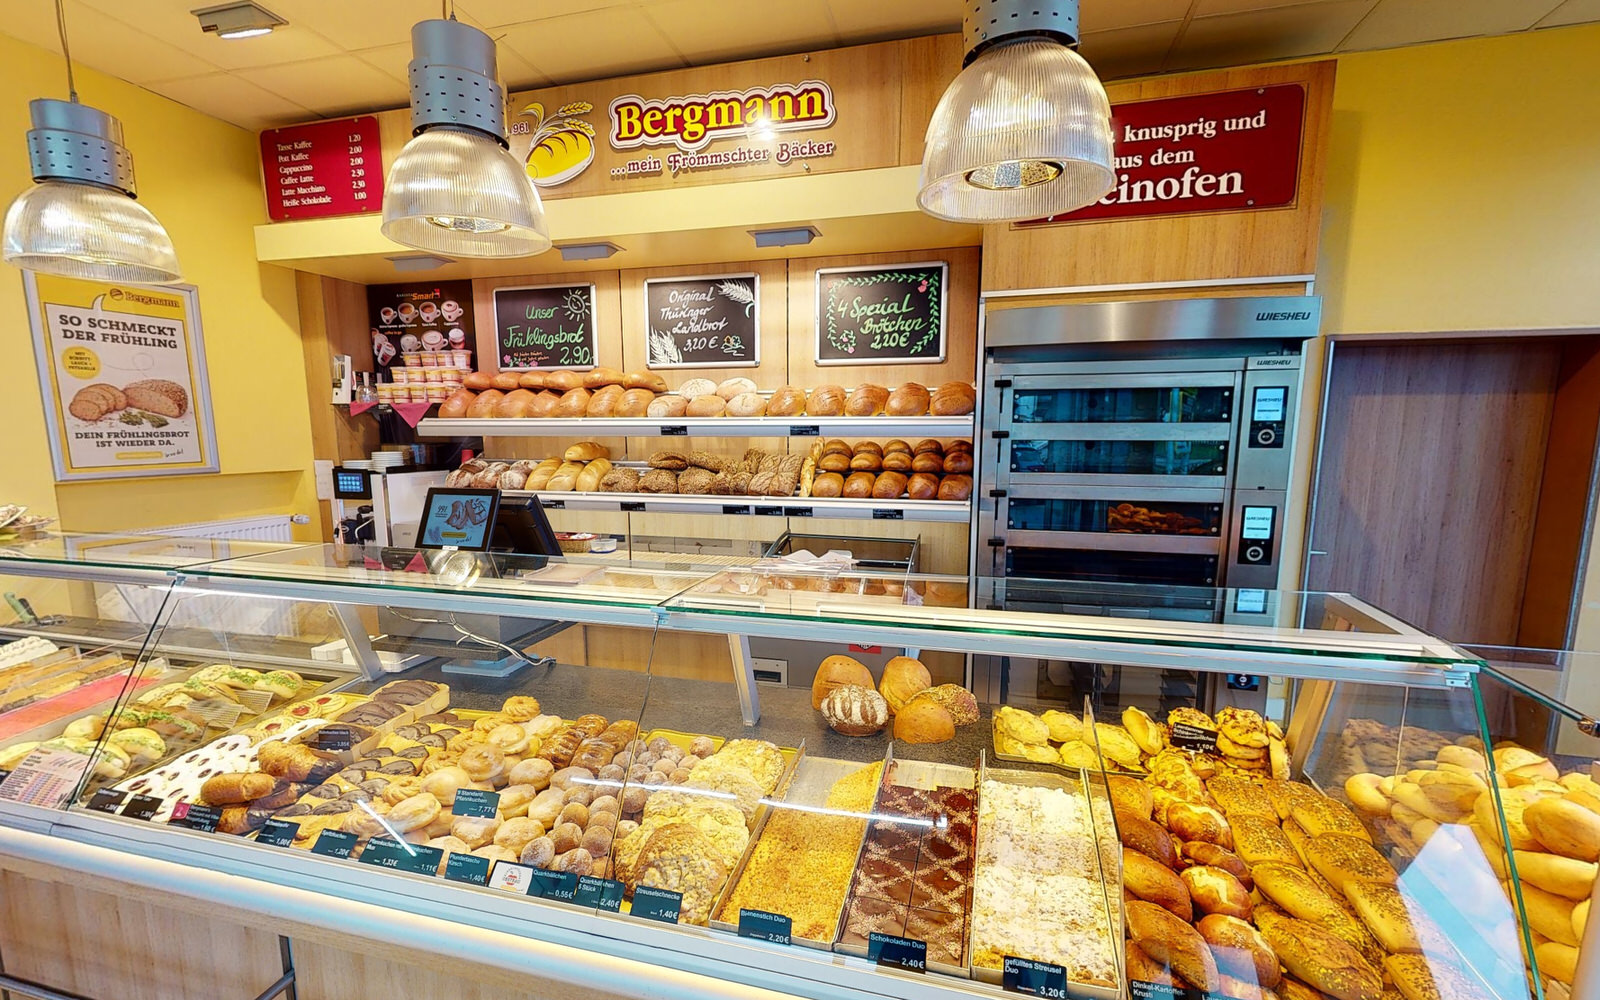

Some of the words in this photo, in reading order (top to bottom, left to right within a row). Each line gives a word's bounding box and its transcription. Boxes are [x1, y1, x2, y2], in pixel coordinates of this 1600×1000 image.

[616, 91, 824, 142] Bergmann
[512, 122, 529, 134] 961
[1123, 117, 1217, 143] knusprig
[1223, 109, 1266, 132] und
[277, 143, 293, 152] Tasse
[294, 140, 312, 150] Kaffee
[348, 134, 361, 143] 1.20
[278, 154, 289, 163] Pott
[291, 152, 309, 162] Kaffee
[348, 145, 363, 154] 2.00
[667, 146, 770, 173] Frömmschter
[776, 139, 835, 163] Bäcker
[1150, 147, 1196, 166] dem
[279, 163, 313, 175] Cappuccino
[350, 157, 364, 166] 2.00
[299, 175, 314, 183] Latte
[281, 187, 296, 196] Latte
[296, 185, 326, 195] Macchiato
[300, 195, 332, 206] Schokolade
[124, 290, 180, 309] Bergmann
[412, 290, 435, 301] Smart
[668, 286, 716, 305] Original
[525, 304, 559, 321] Unser
[838, 300, 848, 320] 4
[1256, 311, 1311, 321] WIESHEU
[59, 313, 82, 327] SO
[88, 317, 177, 338] SCHMECKT
[672, 316, 729, 335] Landbrot
[860, 315, 928, 335] Brötchen
[61, 328, 97, 342] DER
[101, 331, 178, 350] FRÜHLING
[75, 431, 104, 440] DEIN
[106, 428, 190, 440] FRÜHLINGSBROT
[96, 440, 113, 448] IST
[115, 439, 157, 448] WIEDER
[158, 438, 176, 448] DA.
[478, 805, 497, 814] 7,77€
[369, 838, 395, 848] Pfannkuchen
[449, 853, 481, 864] Plundertasche
[421, 863, 438, 873] 1,11€
[533, 869, 567, 880] Quarkbällchen
[554, 889, 573, 899] 0,55€
[635, 887, 681, 901] Streuselschnecke
[600, 898, 620, 909] 2,40€
[658, 909, 679, 920] 1,40€
[774, 915, 786, 923] Duo
[768, 933, 790, 944] 2,20€
[870, 933, 911, 947] Schokoladen
[912, 941, 926, 950] Duo
[901, 957, 925, 969] 2,40€
[1004, 958, 1033, 970] gefülltes
[1034, 963, 1062, 975] Streusel
[1004, 965, 1019, 974] Duo
[1039, 985, 1066, 999] 3,20€
